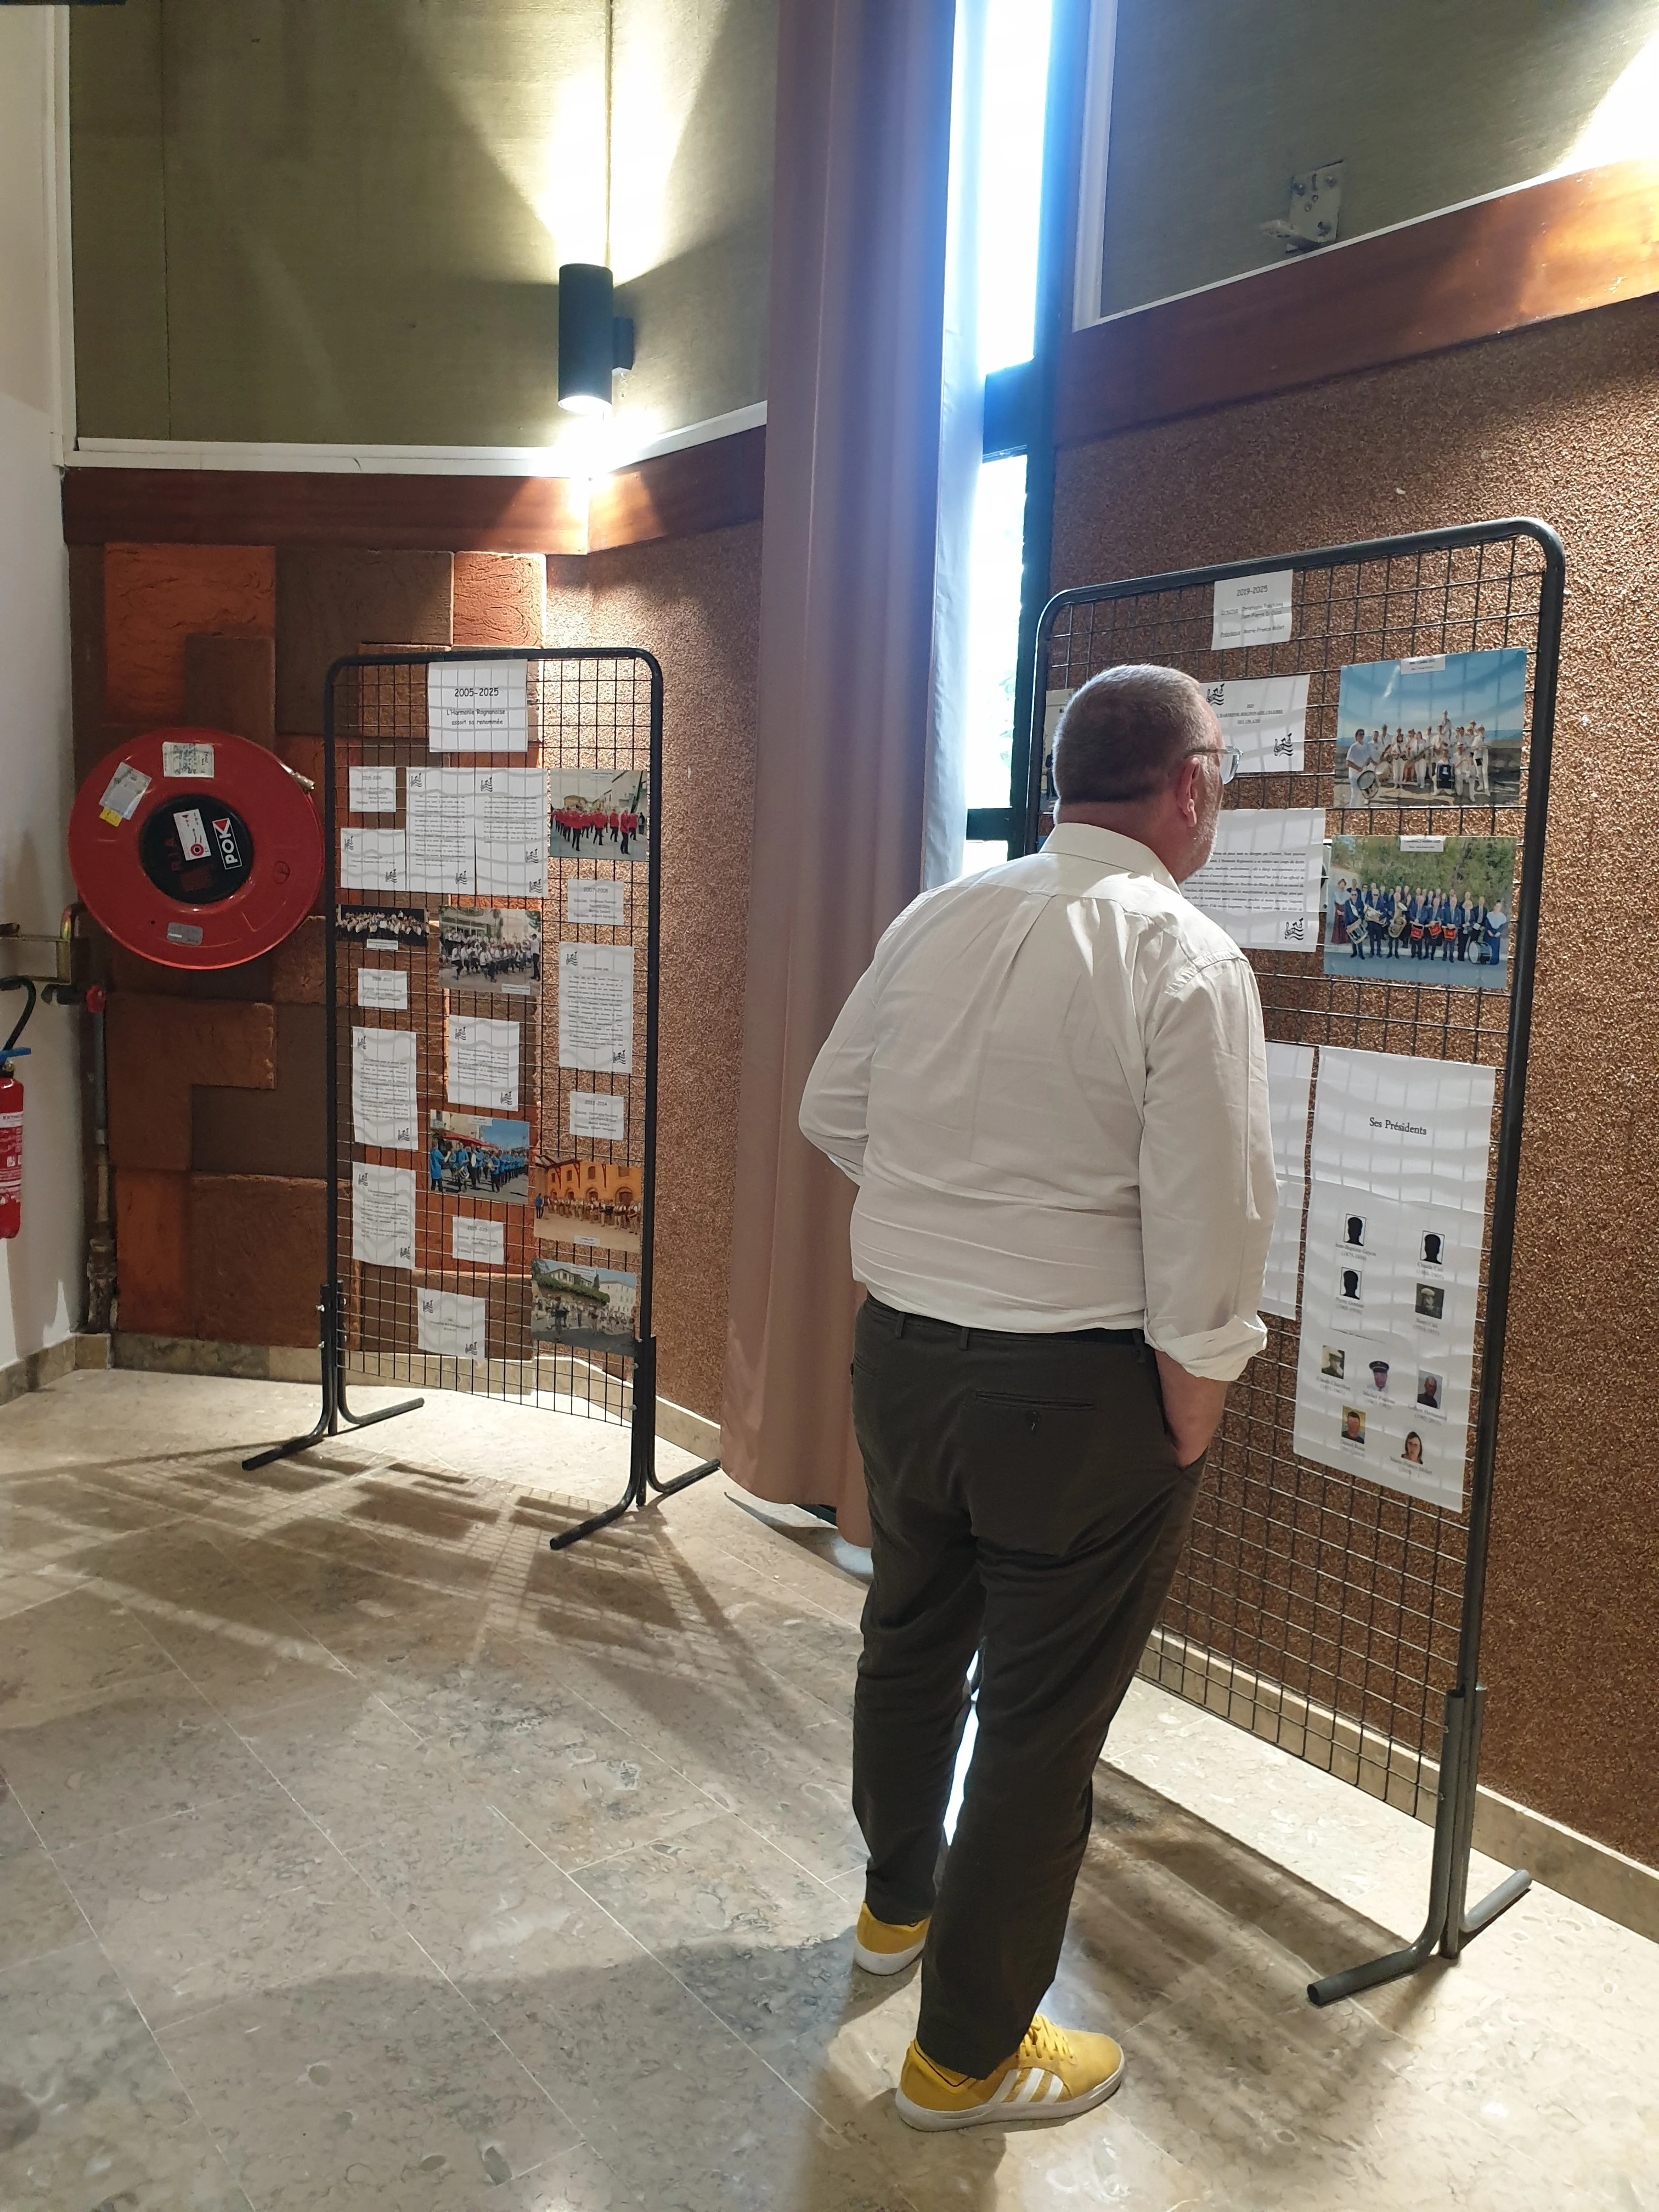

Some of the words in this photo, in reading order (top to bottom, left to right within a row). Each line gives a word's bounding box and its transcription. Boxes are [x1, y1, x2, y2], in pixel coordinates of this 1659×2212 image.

[1237, 585, 1268, 596] 2019-2025
[454, 687, 499, 697] 2005-2025
[213, 818, 238, 865] POK
[1369, 1117, 1382, 1127] Ses
[1385, 1120, 1427, 1135] Présidents
